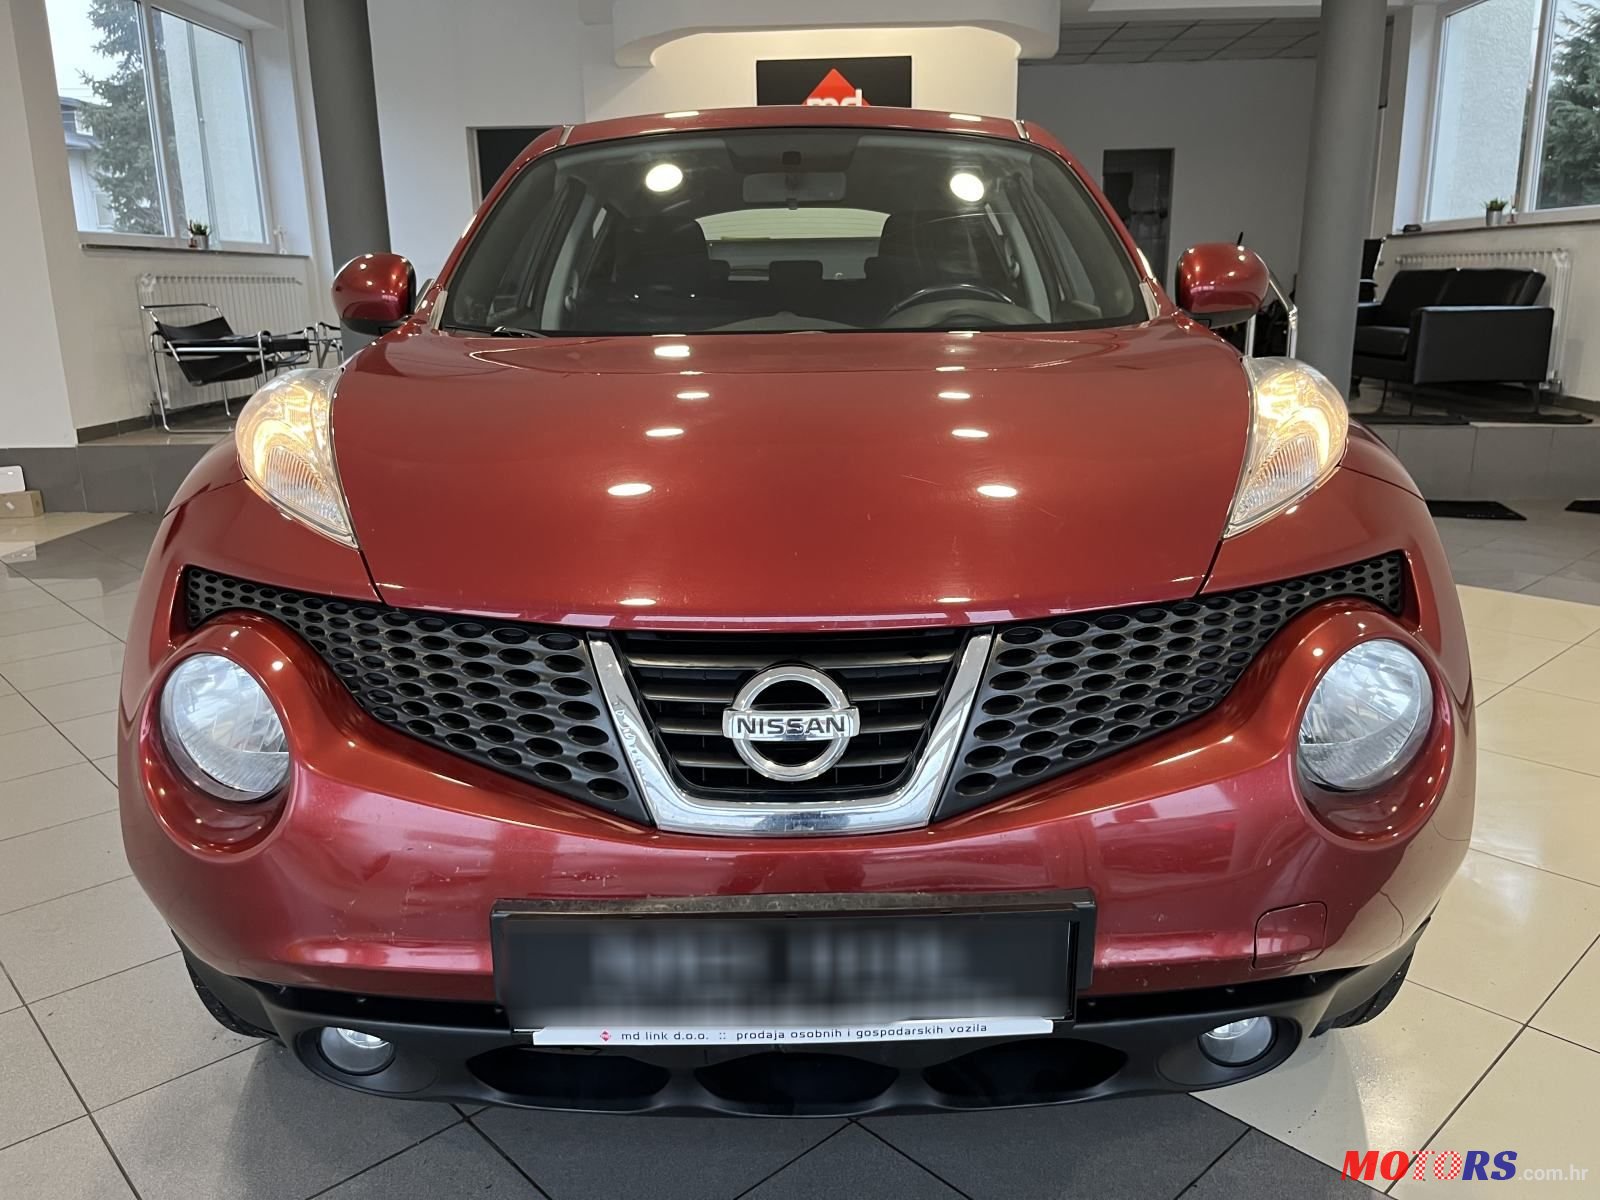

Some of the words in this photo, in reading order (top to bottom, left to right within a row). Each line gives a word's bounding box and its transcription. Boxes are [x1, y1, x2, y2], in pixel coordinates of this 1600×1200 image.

[737, 717, 845, 735] NISSAN
[621, 1032, 640, 1040] md
[645, 1031, 668, 1040] link
[674, 1031, 709, 1040] d.o.o.
[736, 1030, 785, 1041] prodaja
[790, 1028, 842, 1038] osobnih
[856, 1026, 943, 1038] gospodarskih
[949, 1024, 987, 1033] vozila
